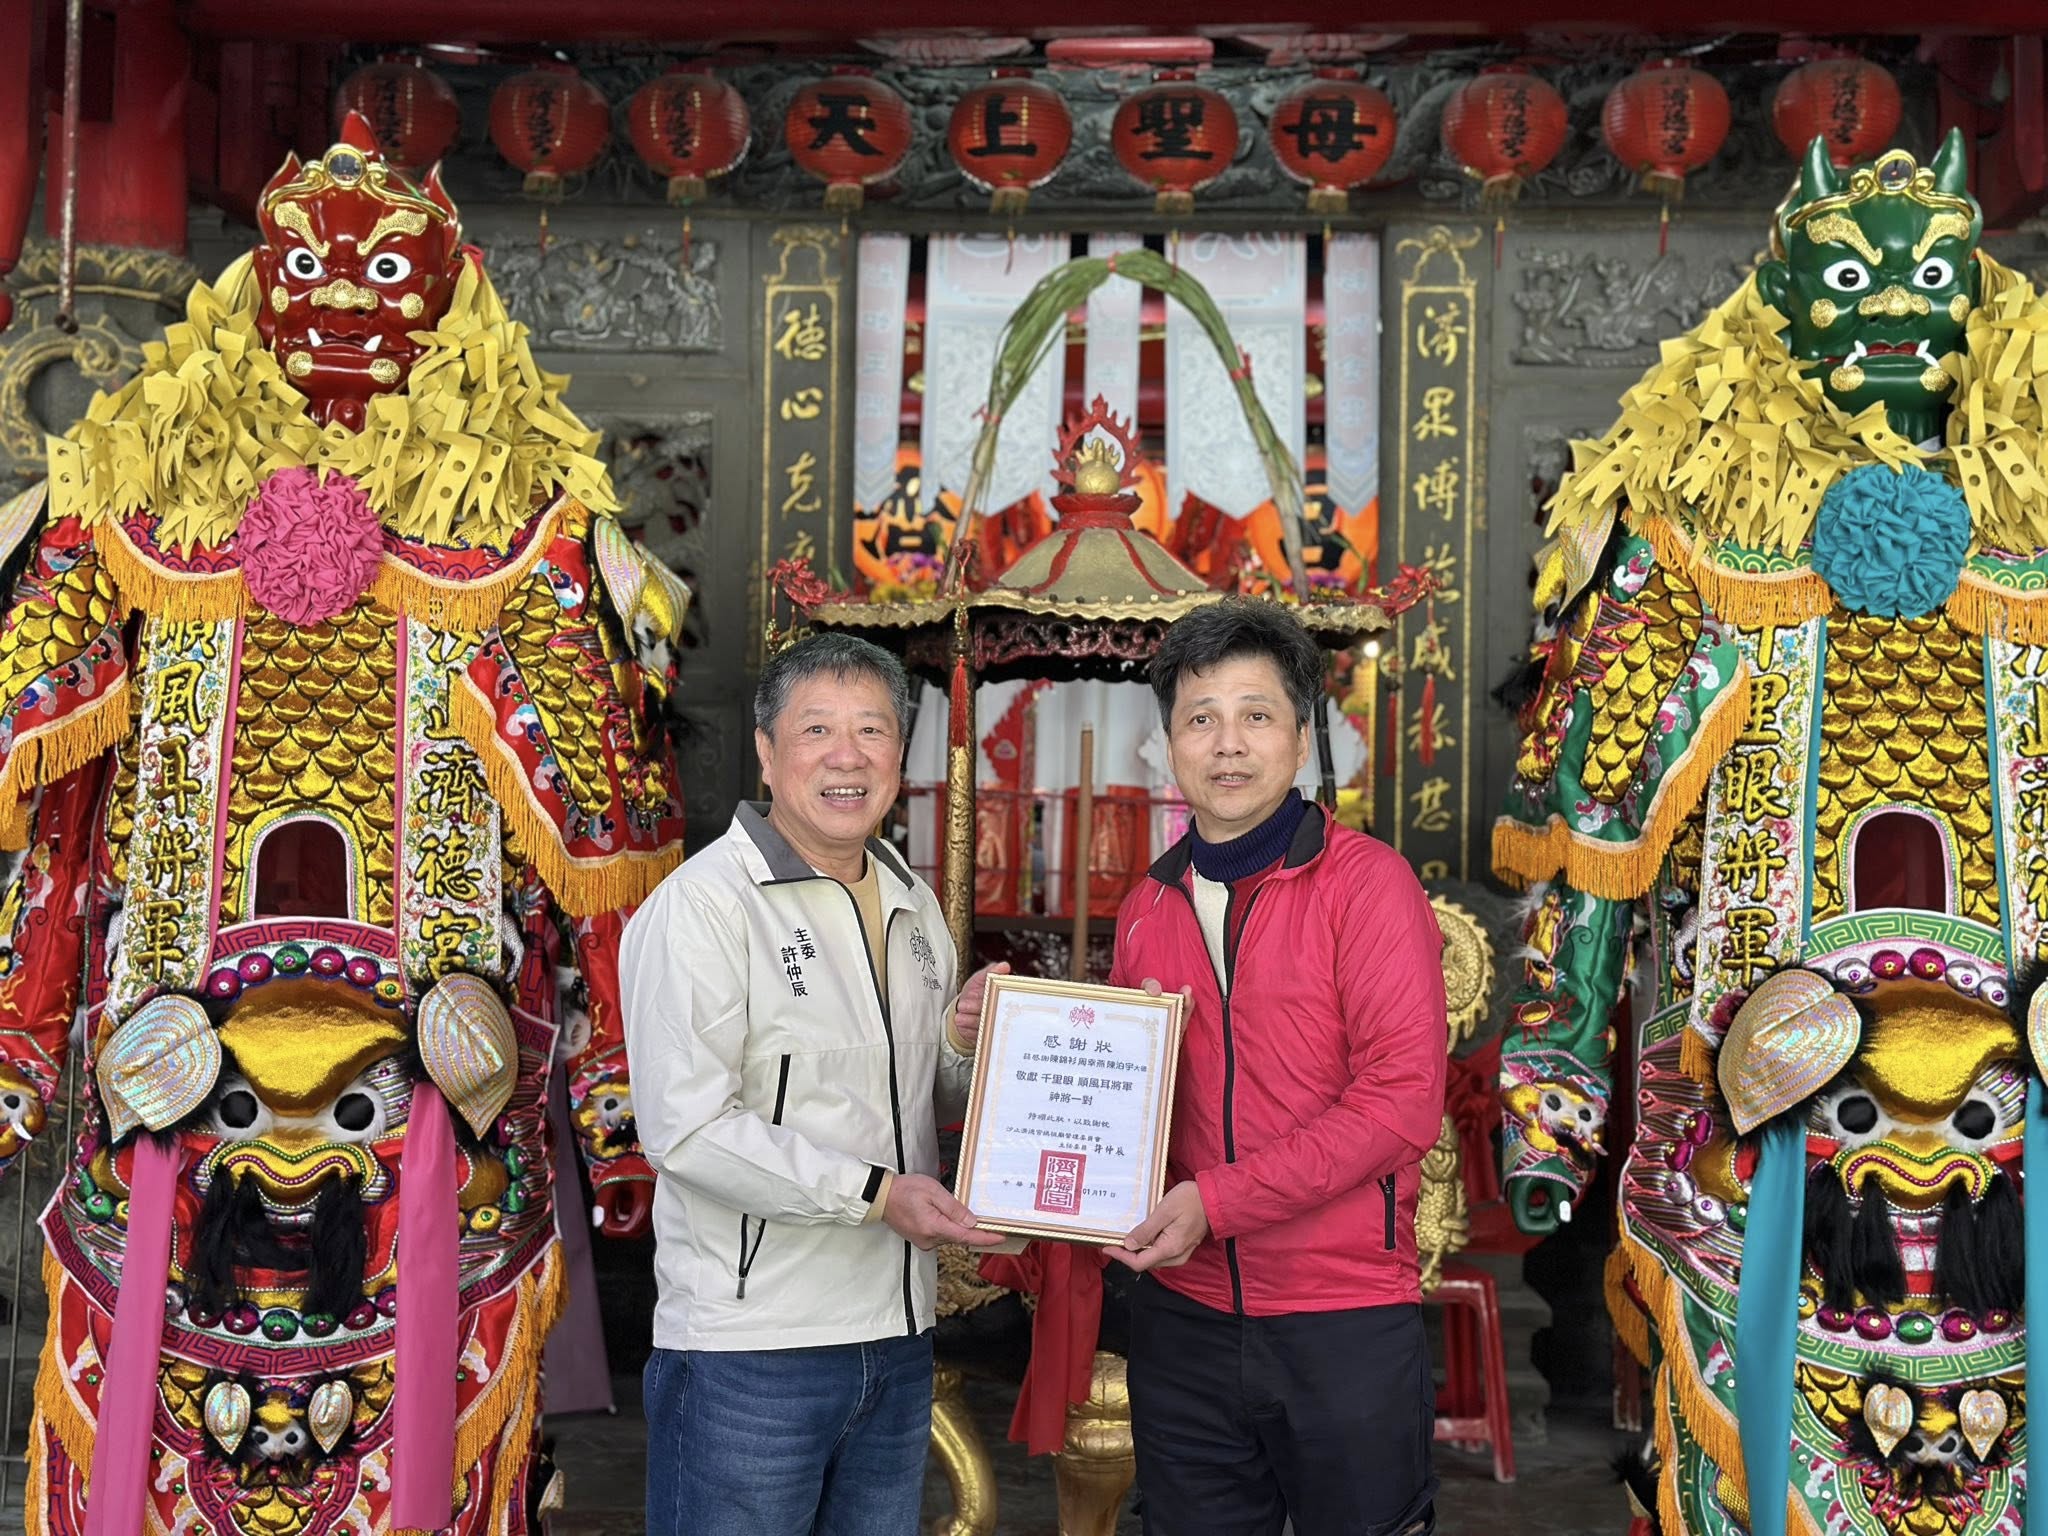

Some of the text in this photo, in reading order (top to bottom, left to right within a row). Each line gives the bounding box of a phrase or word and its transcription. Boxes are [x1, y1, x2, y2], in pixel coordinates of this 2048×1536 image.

[808, 94, 1378, 162] 天 上 聖 母
[794, 928, 816, 960] 主委
[781, 946, 808, 997] 許仲辰
[1043, 1034, 1113, 1053] 感謝狀
[1016, 1070, 1133, 1091] 敬獻 千里眼 順風耳將軍
[1049, 1091, 1093, 1106] 神將一對
